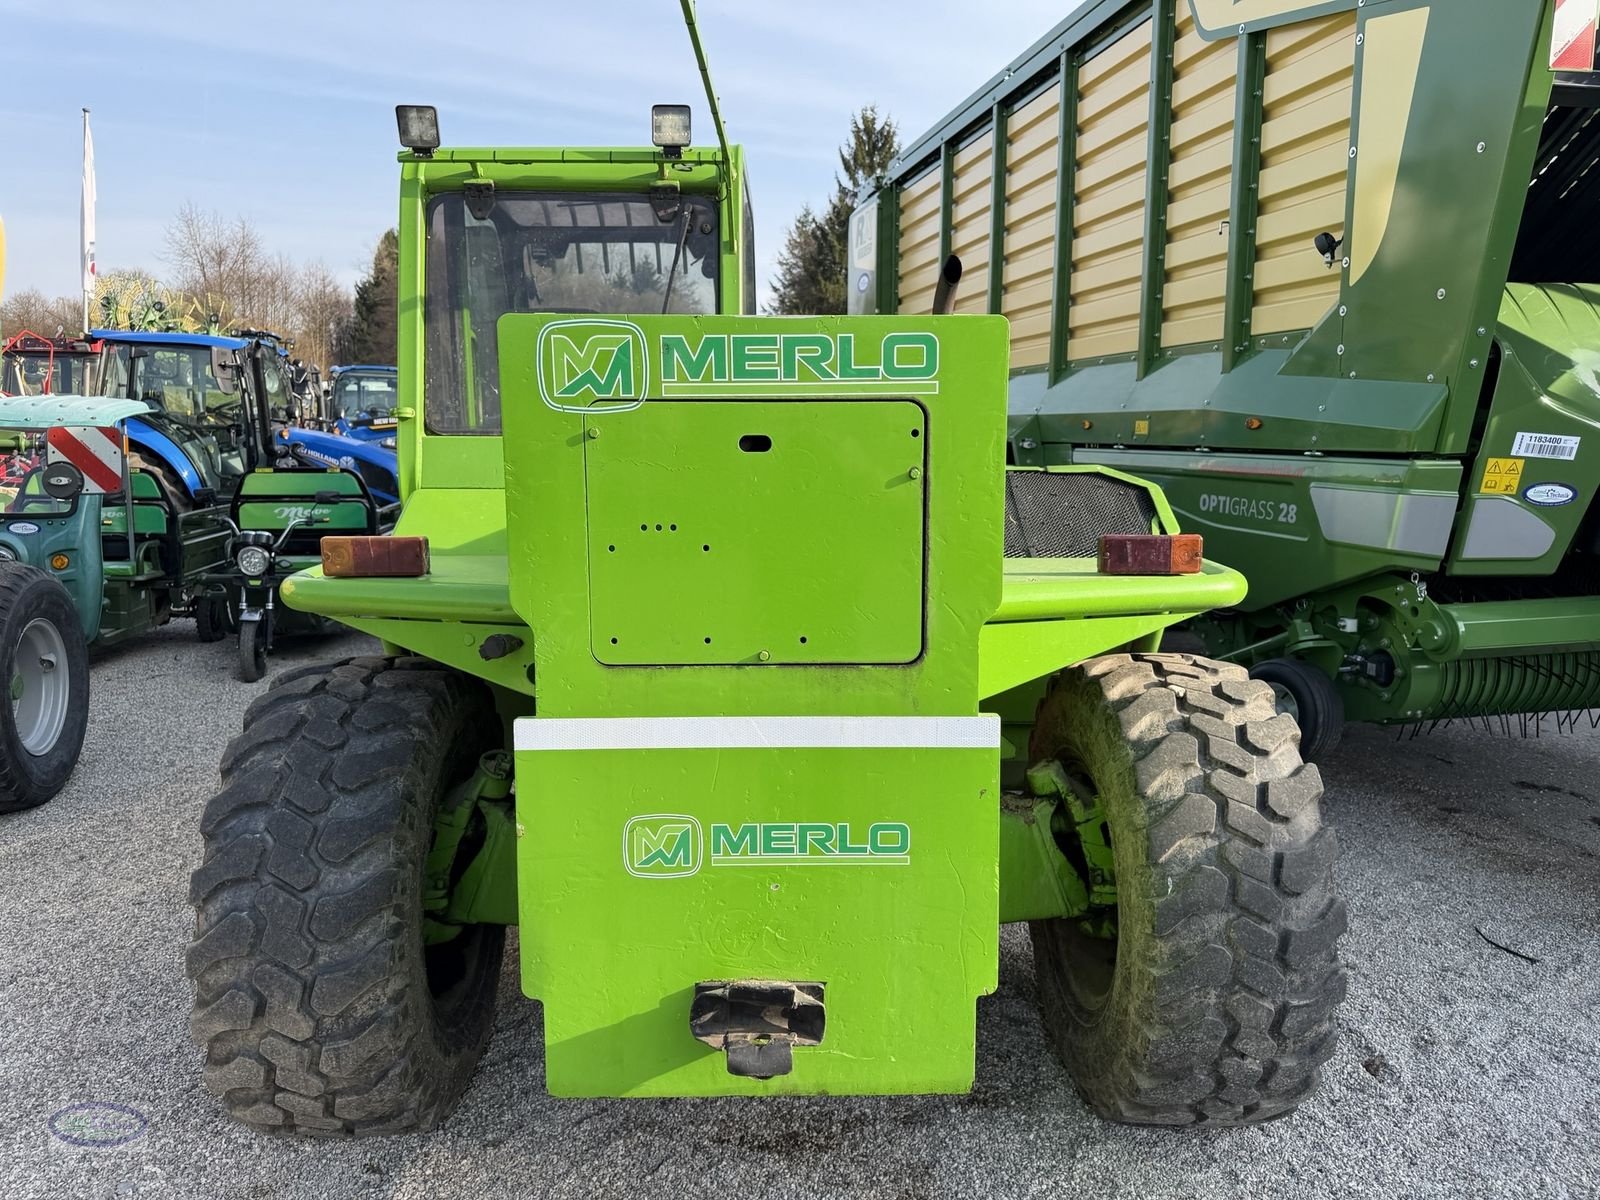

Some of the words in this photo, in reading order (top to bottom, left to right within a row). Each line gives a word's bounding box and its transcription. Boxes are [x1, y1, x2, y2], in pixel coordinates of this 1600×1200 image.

[660, 332, 940, 382] MERLO
[1529, 435, 1562, 444] 1183400
[308, 449, 339, 464] HOLLAND
[1199, 494, 1274, 520] OPTIGRASS
[1278, 502, 1297, 523] 28
[711, 822, 910, 855] MERLO
